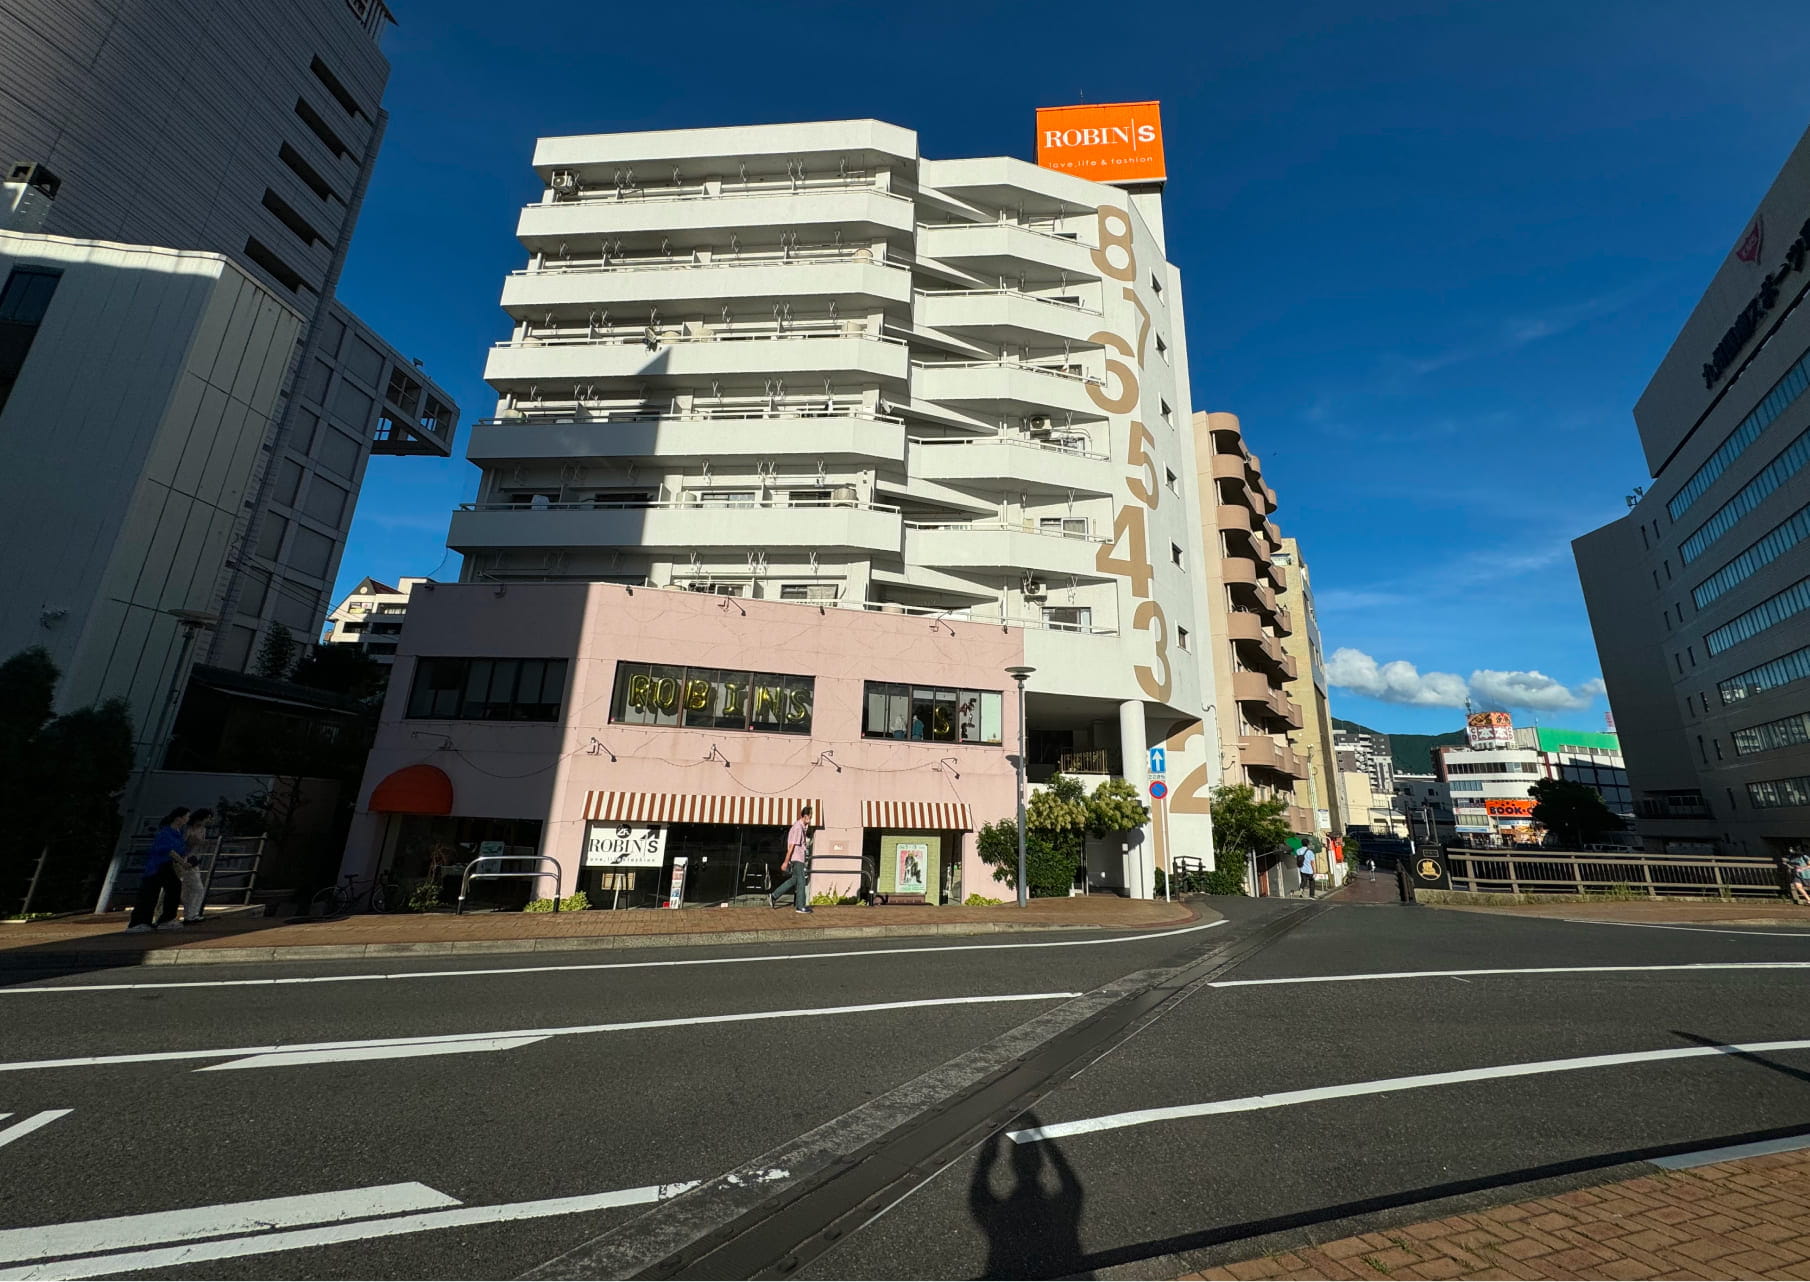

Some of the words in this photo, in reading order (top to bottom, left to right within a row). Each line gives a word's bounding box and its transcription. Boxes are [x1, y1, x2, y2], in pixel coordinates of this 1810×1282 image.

[1101, 158, 1107, 166] &
[1111, 155, 1153, 164] fashion
[1090, 205, 1136, 281] 8
[1085, 331, 1139, 414] 6
[1126, 421, 1160, 510] 5
[1096, 505, 1154, 598] 4
[1133, 600, 1172, 703] 3
[629, 674, 812, 721] ROBINS
